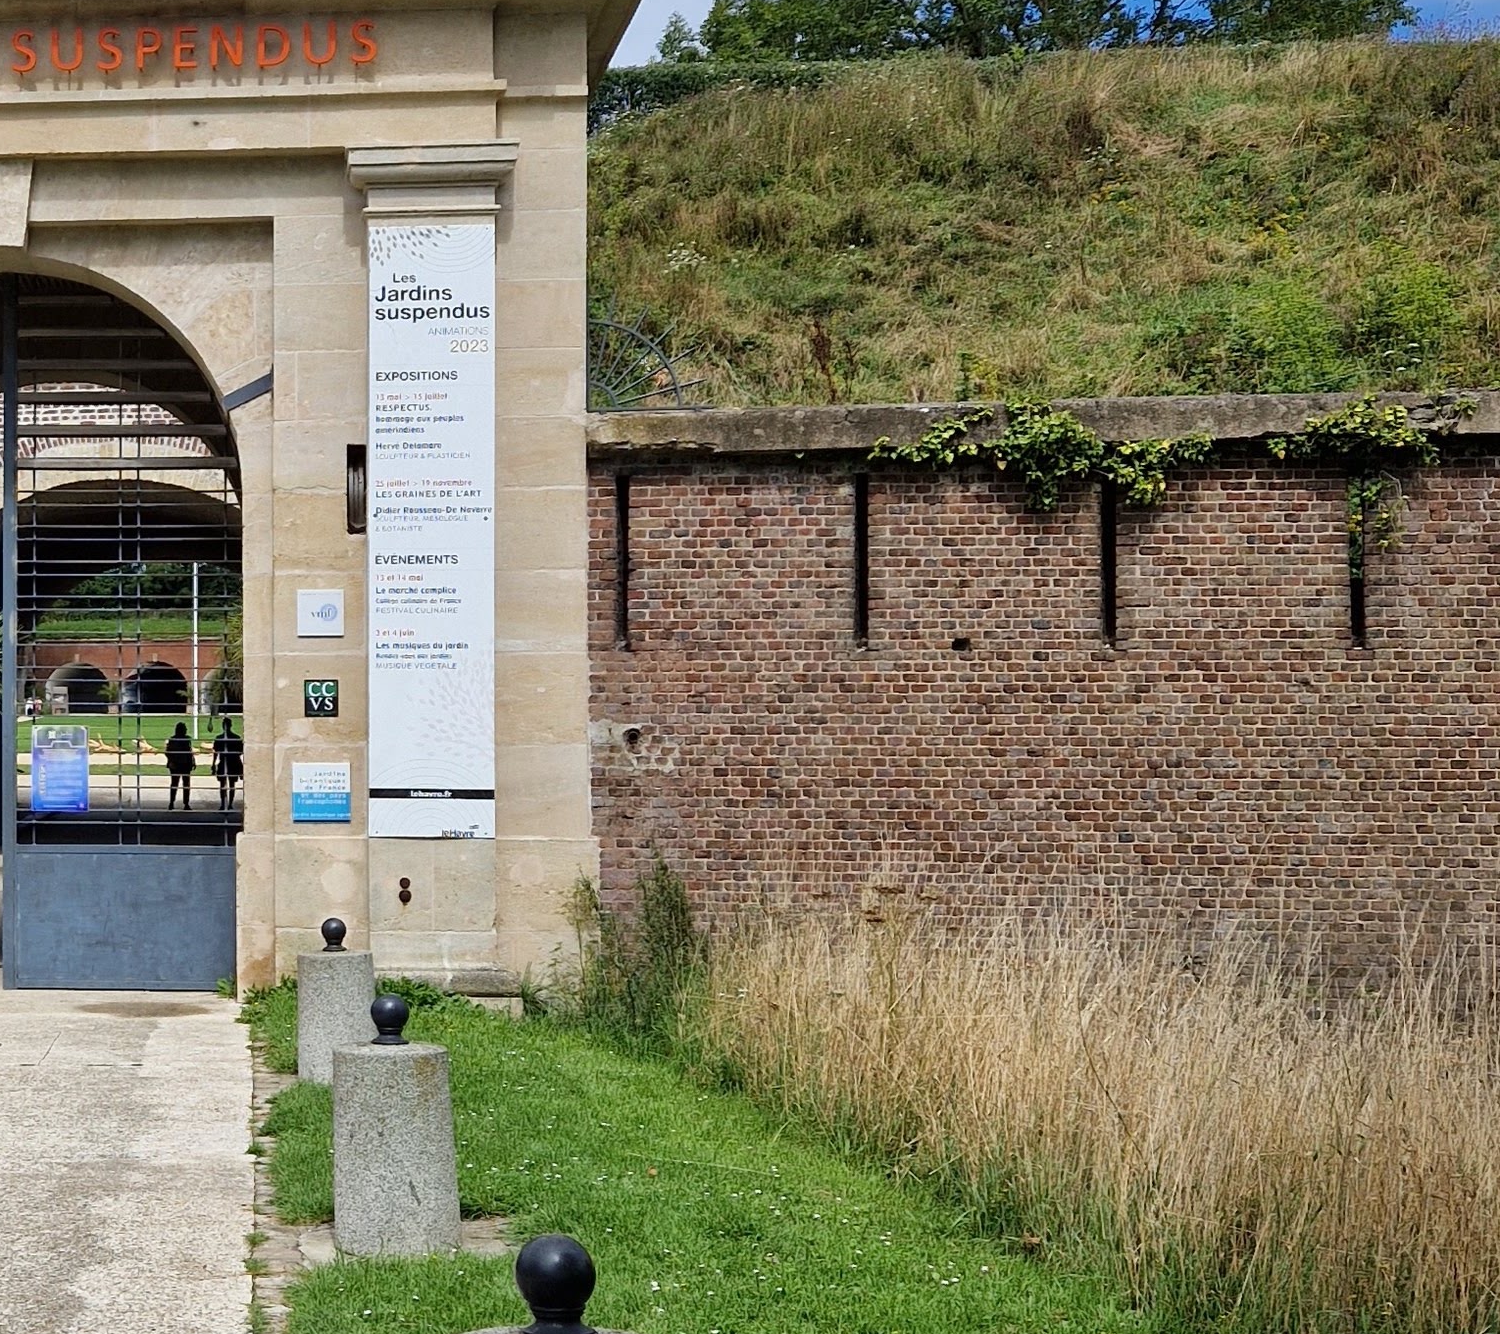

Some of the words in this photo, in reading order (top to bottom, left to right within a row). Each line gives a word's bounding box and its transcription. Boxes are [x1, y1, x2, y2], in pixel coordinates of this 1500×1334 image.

[11, 19, 379, 73] SUSPENDUS
[392, 272, 417, 284] Les
[375, 285, 453, 302] Jardins
[375, 302, 491, 323] suspendus
[427, 326, 489, 336] ANIMATIONS
[450, 339, 489, 353] 2023
[375, 370, 458, 382] EXPOSITIONS
[375, 490, 393, 498] LES
[395, 490, 437, 498] GRAINES
[439, 490, 453, 498] DE
[374, 552, 459, 565] ÉVÉNEMENTS
[375, 586, 386, 594] Le
[399, 629, 415, 638] juin
[445, 642, 469, 651] jardin
[308, 681, 335, 697] CC
[309, 697, 334, 711] VS
